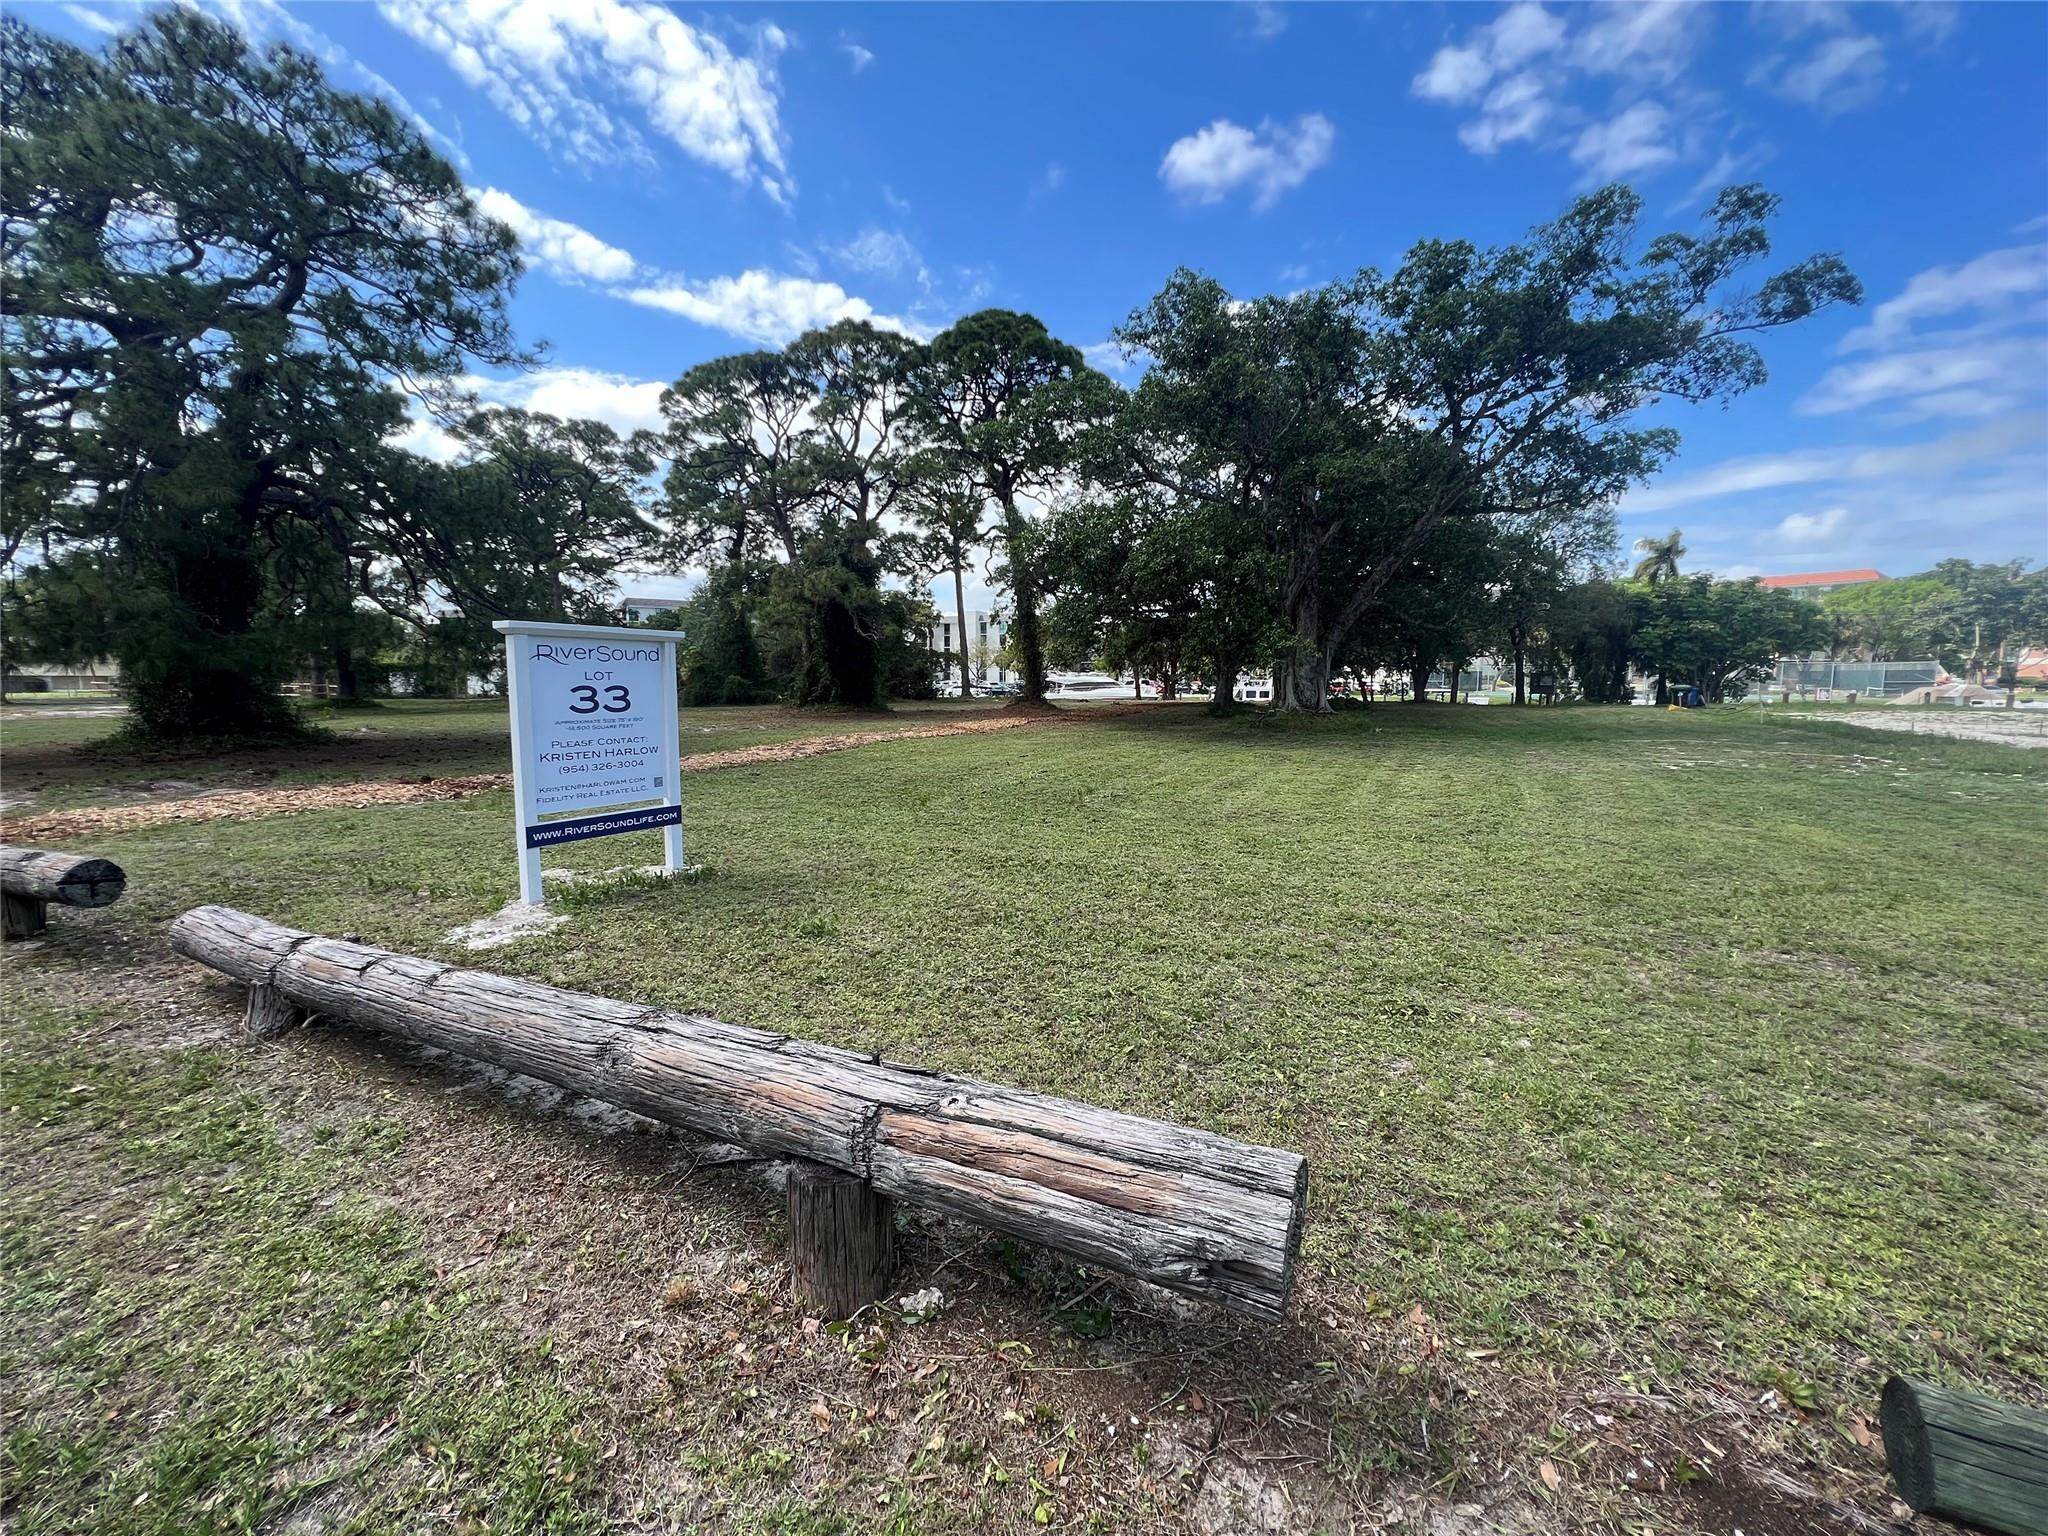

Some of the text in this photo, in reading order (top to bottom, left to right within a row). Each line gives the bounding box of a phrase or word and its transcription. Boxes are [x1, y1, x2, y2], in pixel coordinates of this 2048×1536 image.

[584, 671, 613, 681] LOT
[569, 685, 631, 714] 33
[551, 736, 648, 748] PLEASE CONTACT:
[540, 746, 658, 762] KRISTEN HARLOW
[559, 760, 644, 775] (954) 326-3004
[539, 777, 646, 793] KRISTEN@HARLOWAM.COM
[536, 795, 577, 804] FIDELITY
[600, 788, 630, 796] ESTATE
